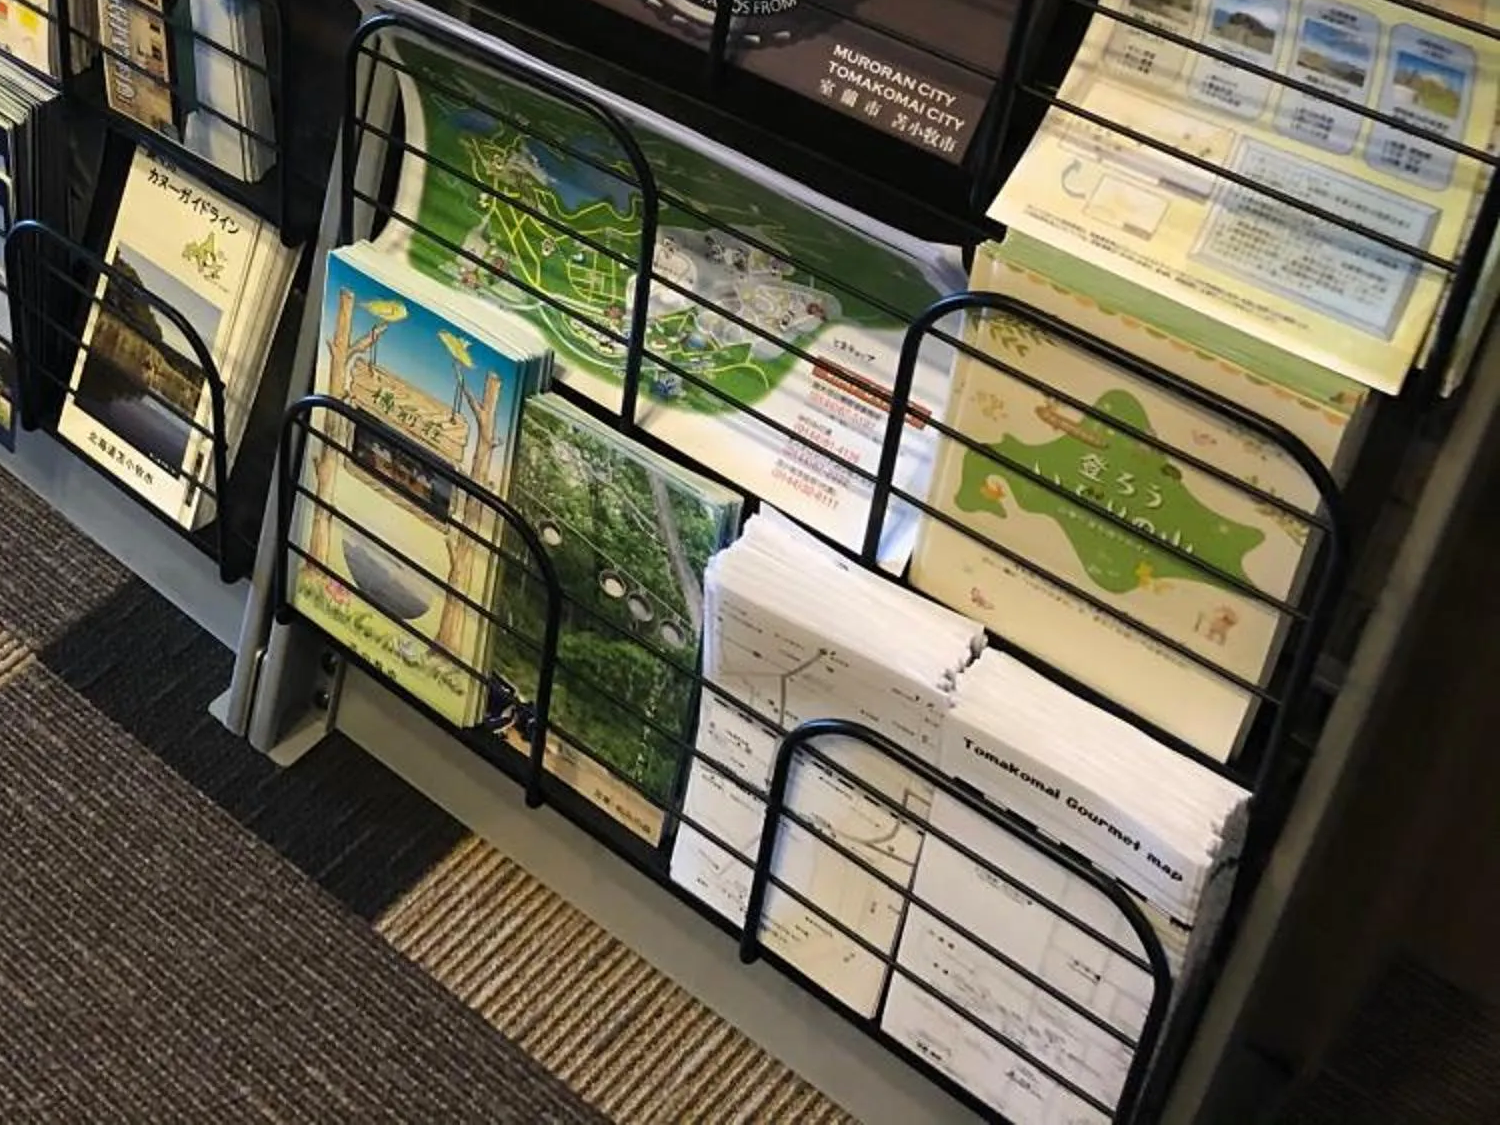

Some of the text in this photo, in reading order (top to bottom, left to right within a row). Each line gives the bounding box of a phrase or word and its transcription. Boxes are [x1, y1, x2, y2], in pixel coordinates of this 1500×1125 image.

[828, 60, 966, 133] TOMAKOMAI CITY
[832, 44, 957, 108] MURORAN CITY
[891, 111, 958, 152] 苫小牧市
[147, 167, 241, 236] カヌーガイドライン
[1078, 452, 1164, 510] 登ろう
[963, 736, 1184, 883] Tomakomai Gourmet map
